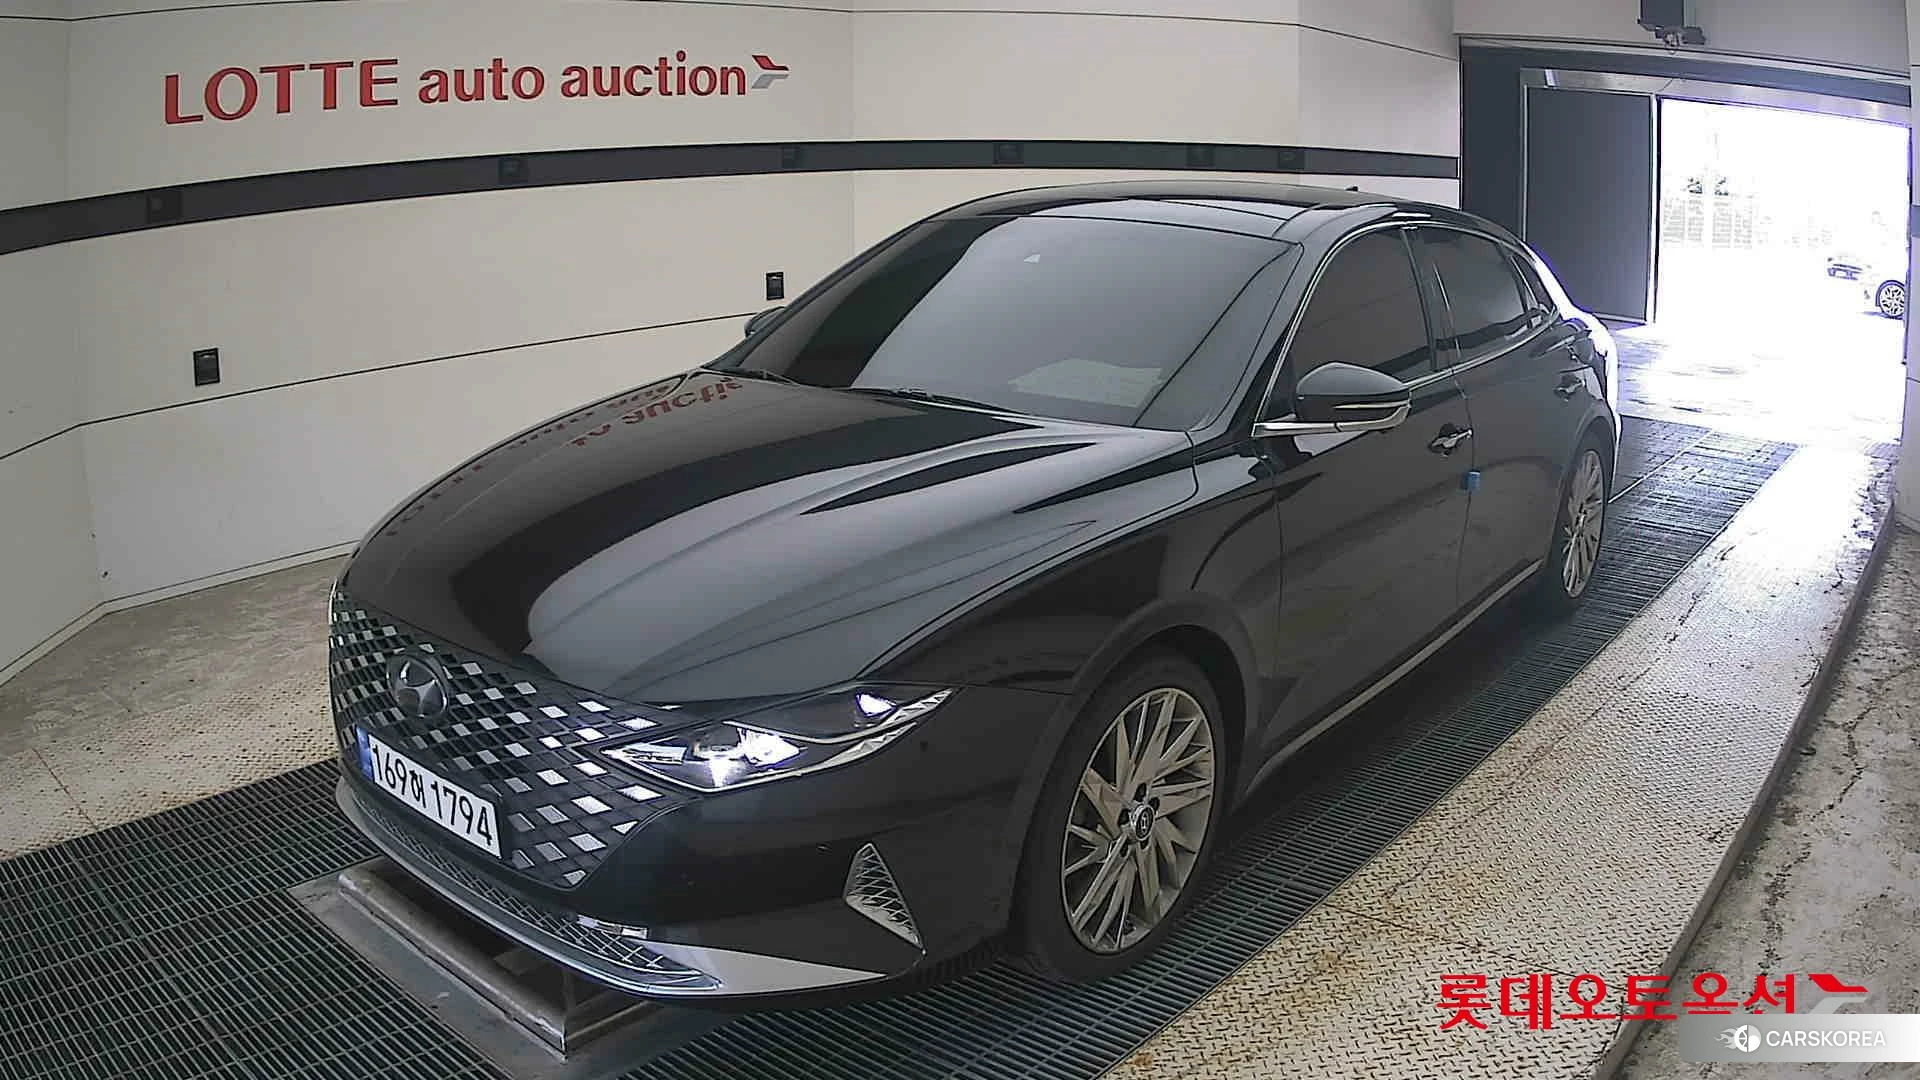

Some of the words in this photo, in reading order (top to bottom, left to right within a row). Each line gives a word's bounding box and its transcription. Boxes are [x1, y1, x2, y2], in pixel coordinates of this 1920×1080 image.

[164, 58, 399, 125] LOTTE
[418, 57, 545, 104] auto
[560, 50, 747, 97] auction
[431, 781, 492, 846] 1794
